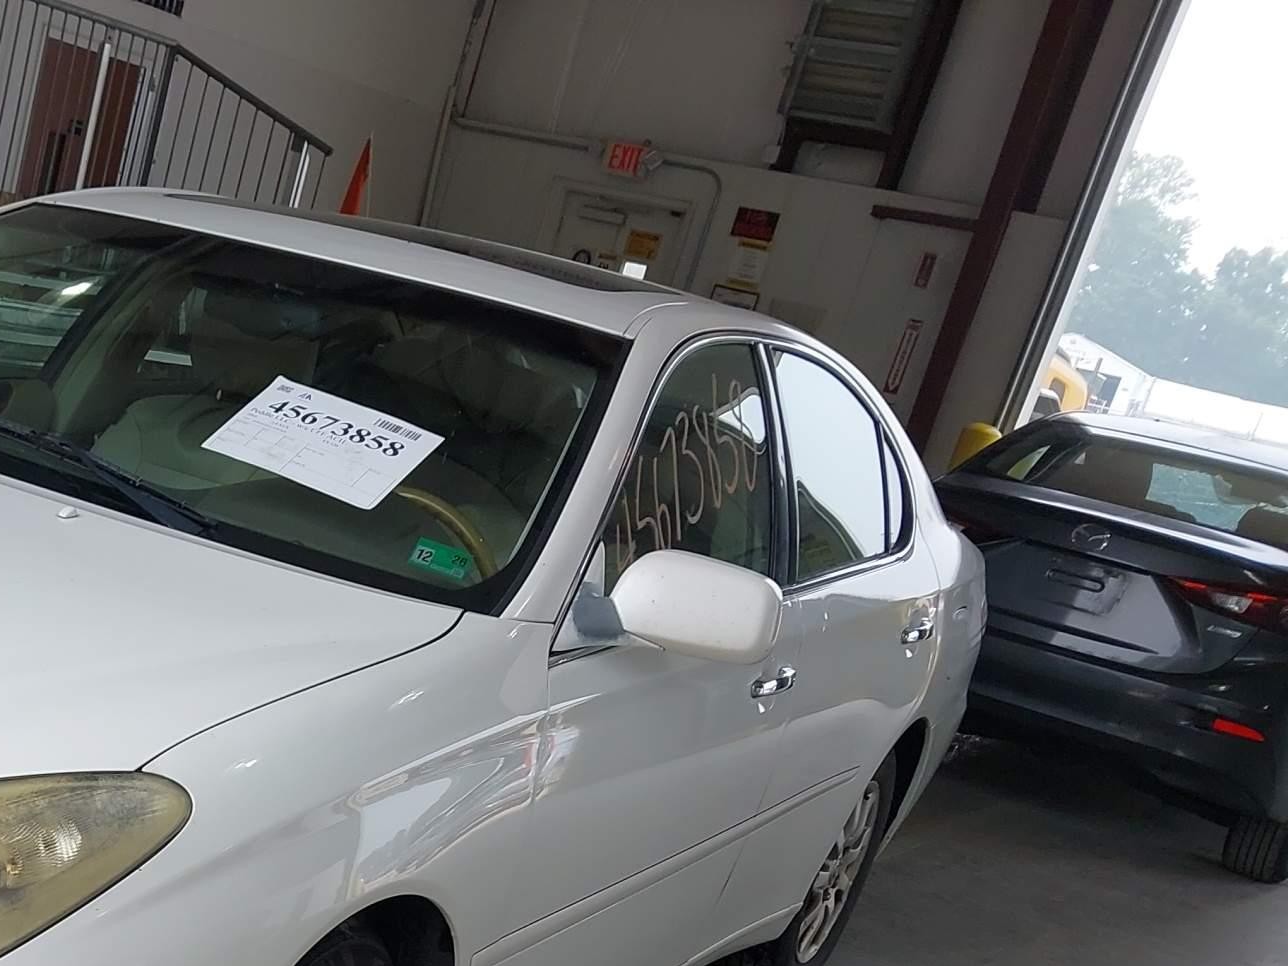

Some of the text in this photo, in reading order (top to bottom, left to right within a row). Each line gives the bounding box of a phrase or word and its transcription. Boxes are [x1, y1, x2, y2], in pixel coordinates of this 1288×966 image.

[607, 143, 644, 177] EXIT
[268, 400, 406, 458] 45673858
[415, 548, 434, 564] 12
